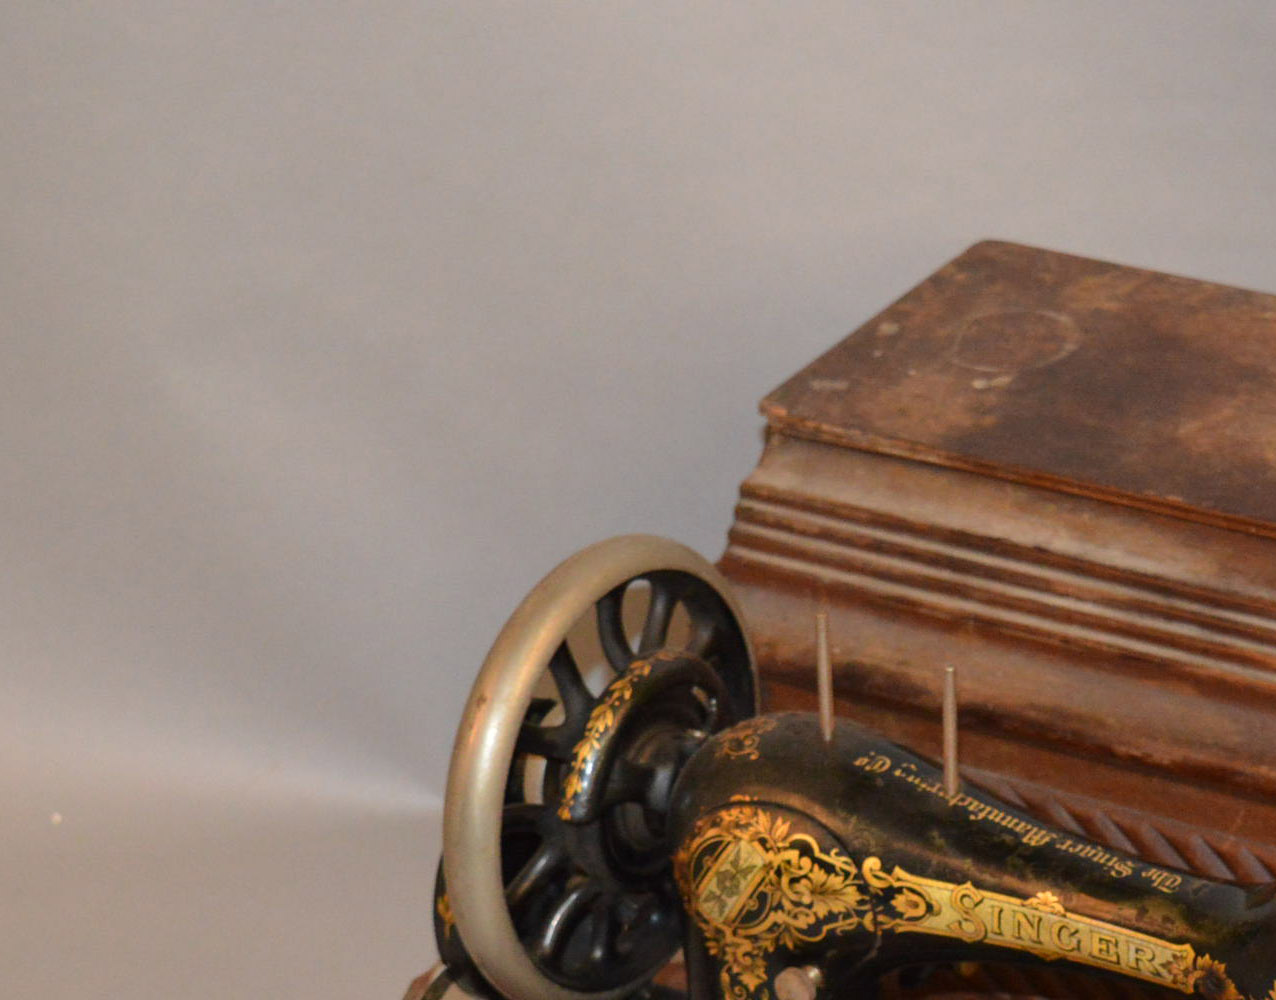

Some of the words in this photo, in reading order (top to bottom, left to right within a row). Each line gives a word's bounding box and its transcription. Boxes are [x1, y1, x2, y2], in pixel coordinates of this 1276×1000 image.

[1055, 839, 1137, 879] Singer
[1141, 867, 1183, 894] The
[949, 881, 1169, 978] SINGER
